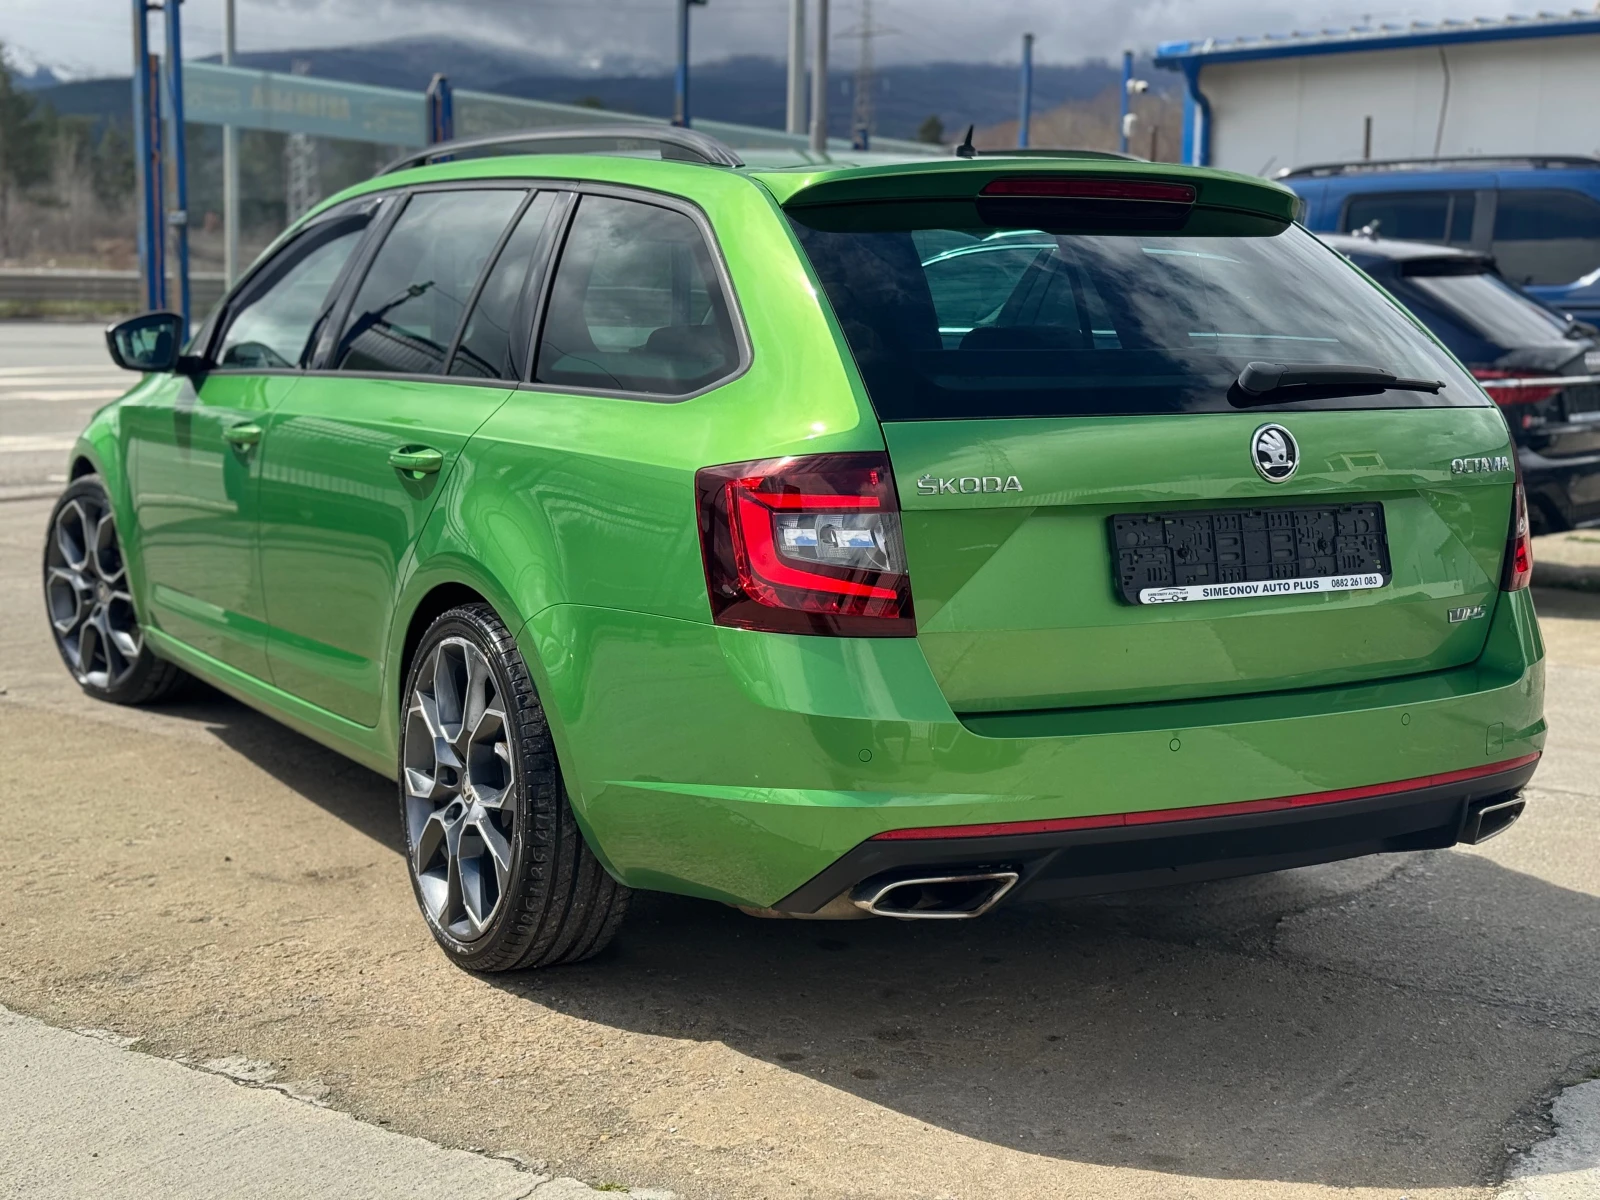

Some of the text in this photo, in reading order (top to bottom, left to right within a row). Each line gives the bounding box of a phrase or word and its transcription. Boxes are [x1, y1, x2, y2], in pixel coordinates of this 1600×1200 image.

[1451, 456, 1510, 474] OCTAVIA
[917, 473, 1024, 496] ŠKODA
[1202, 576, 1378, 598] SIMEONOV AUTO PLUS 0882 261 083
